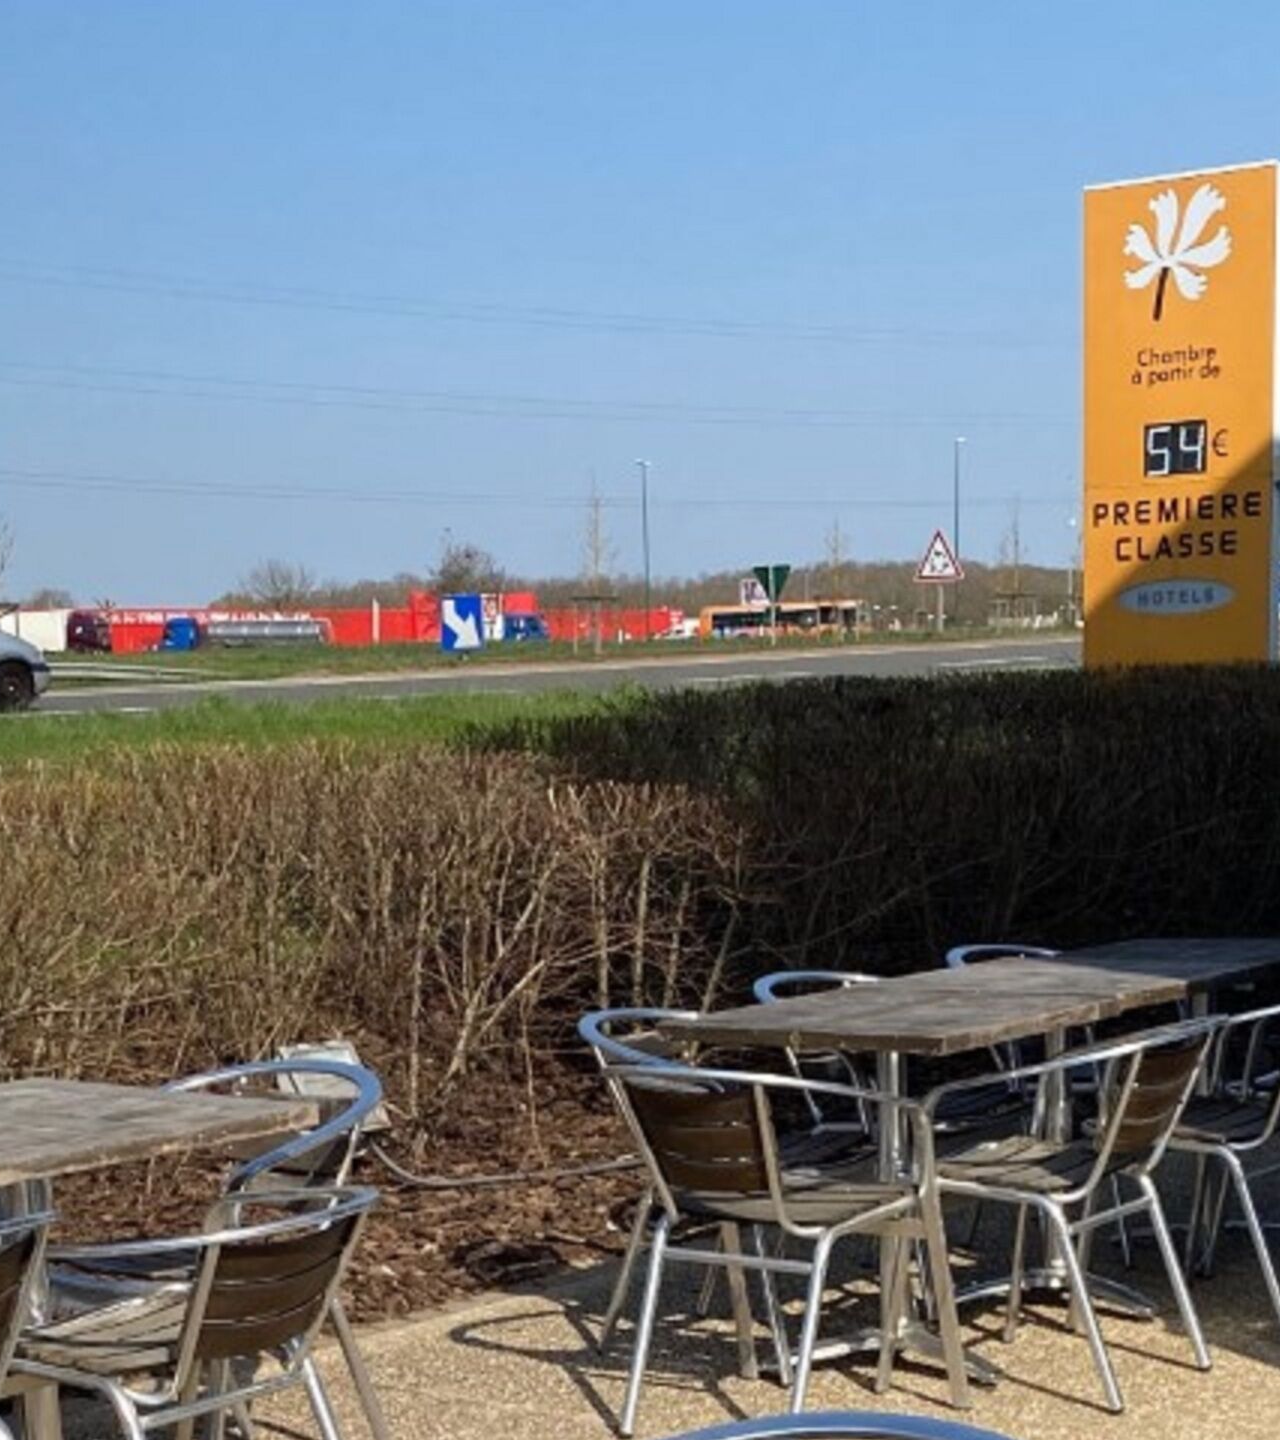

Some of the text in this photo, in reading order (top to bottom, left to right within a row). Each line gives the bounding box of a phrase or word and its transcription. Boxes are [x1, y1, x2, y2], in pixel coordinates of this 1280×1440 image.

[1137, 344, 1216, 367] Chambre
[1131, 360, 1221, 388] à partir de
[1092, 491, 1262, 527] PREMIERE
[1116, 529, 1238, 562] CLASSE
[1136, 587, 1214, 607] HOTELS
